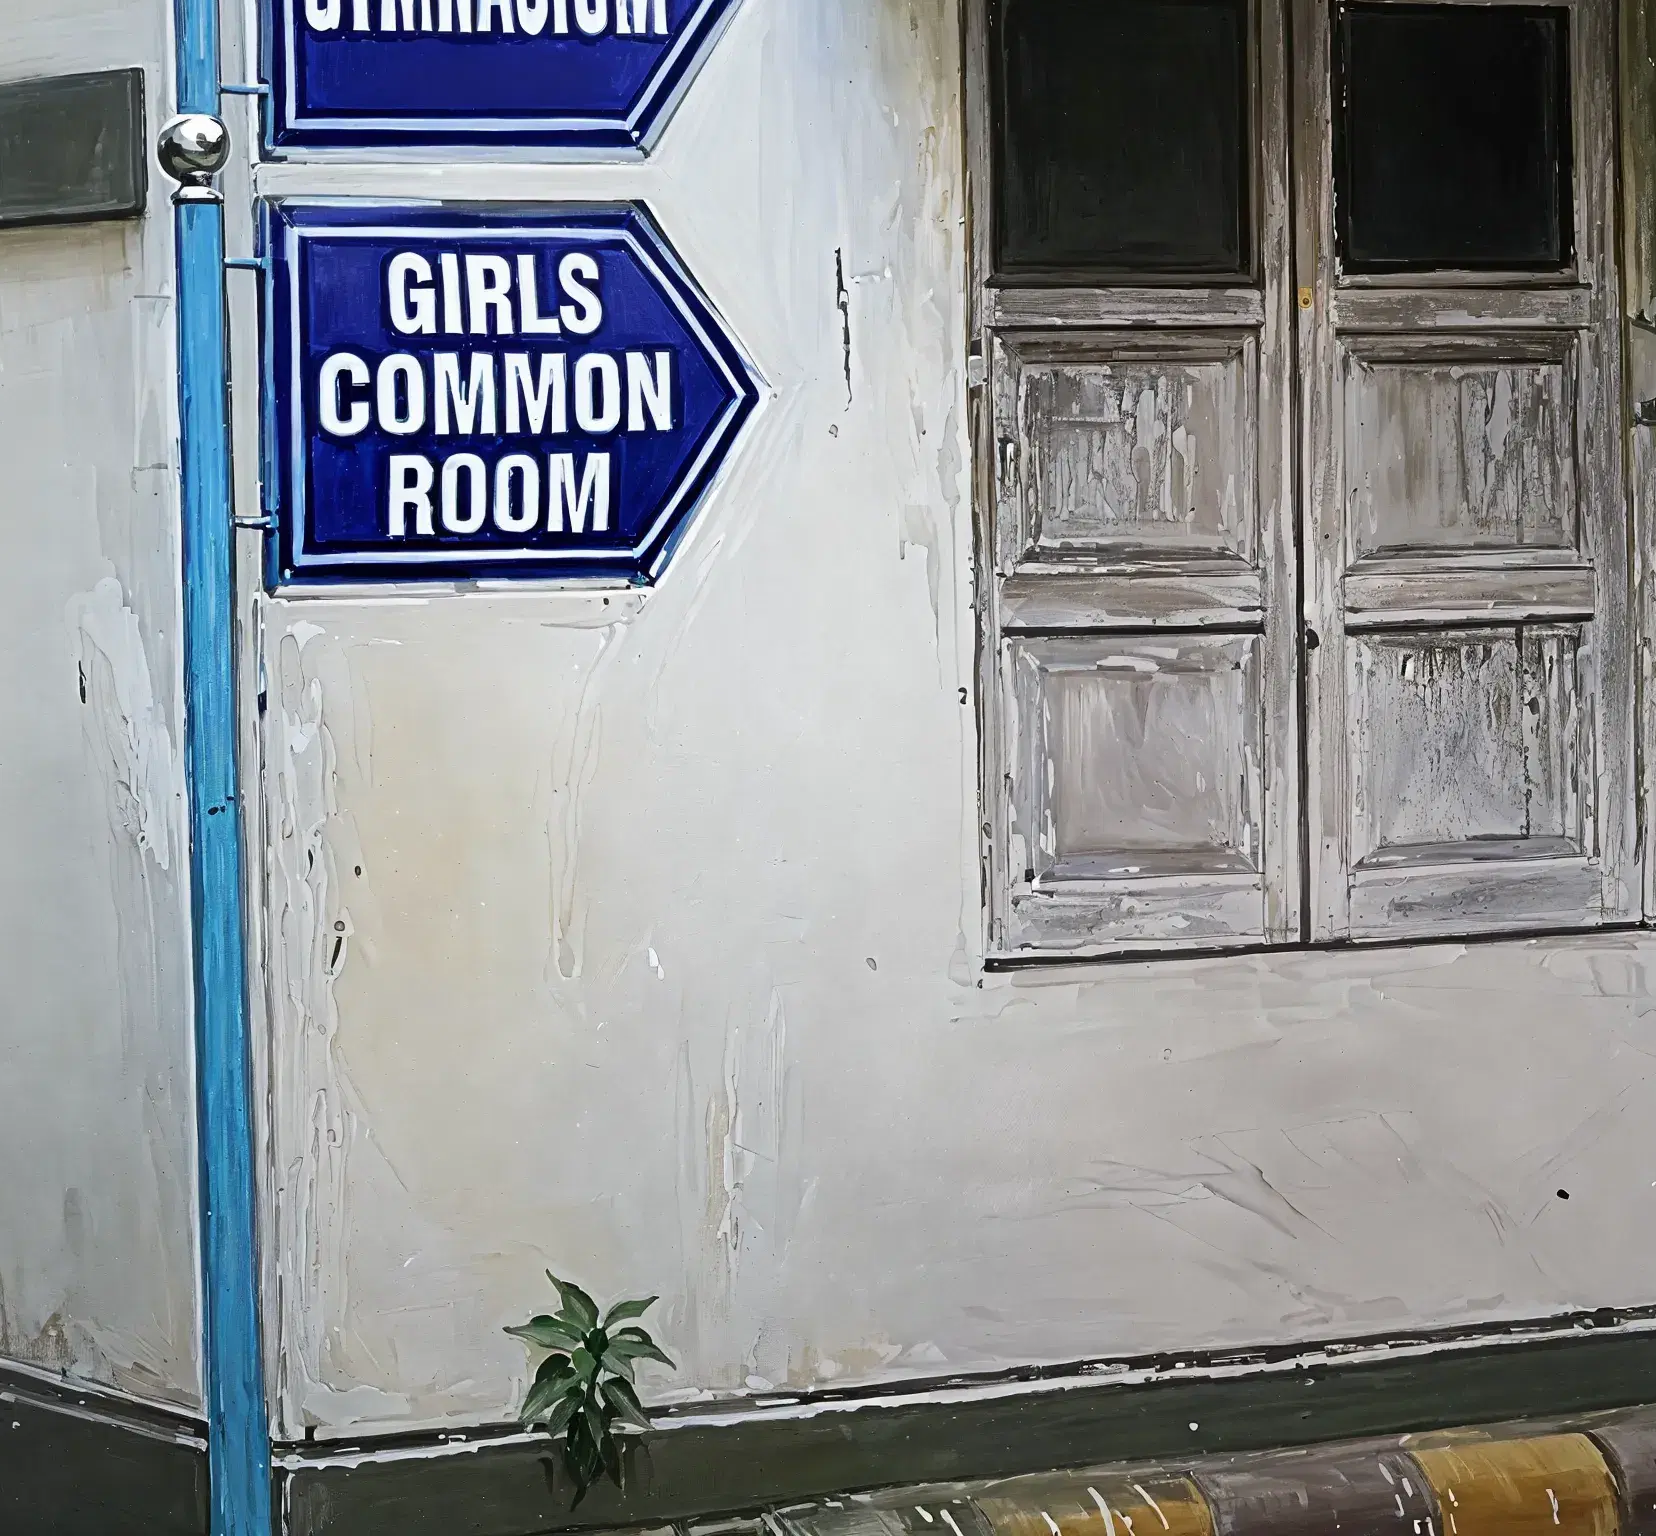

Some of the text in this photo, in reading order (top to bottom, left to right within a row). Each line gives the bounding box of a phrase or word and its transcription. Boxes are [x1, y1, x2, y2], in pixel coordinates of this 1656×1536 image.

[389, 252, 602, 334] GIRLS
[320, 352, 672, 436] COMMON
[387, 453, 609, 536] ROOM
